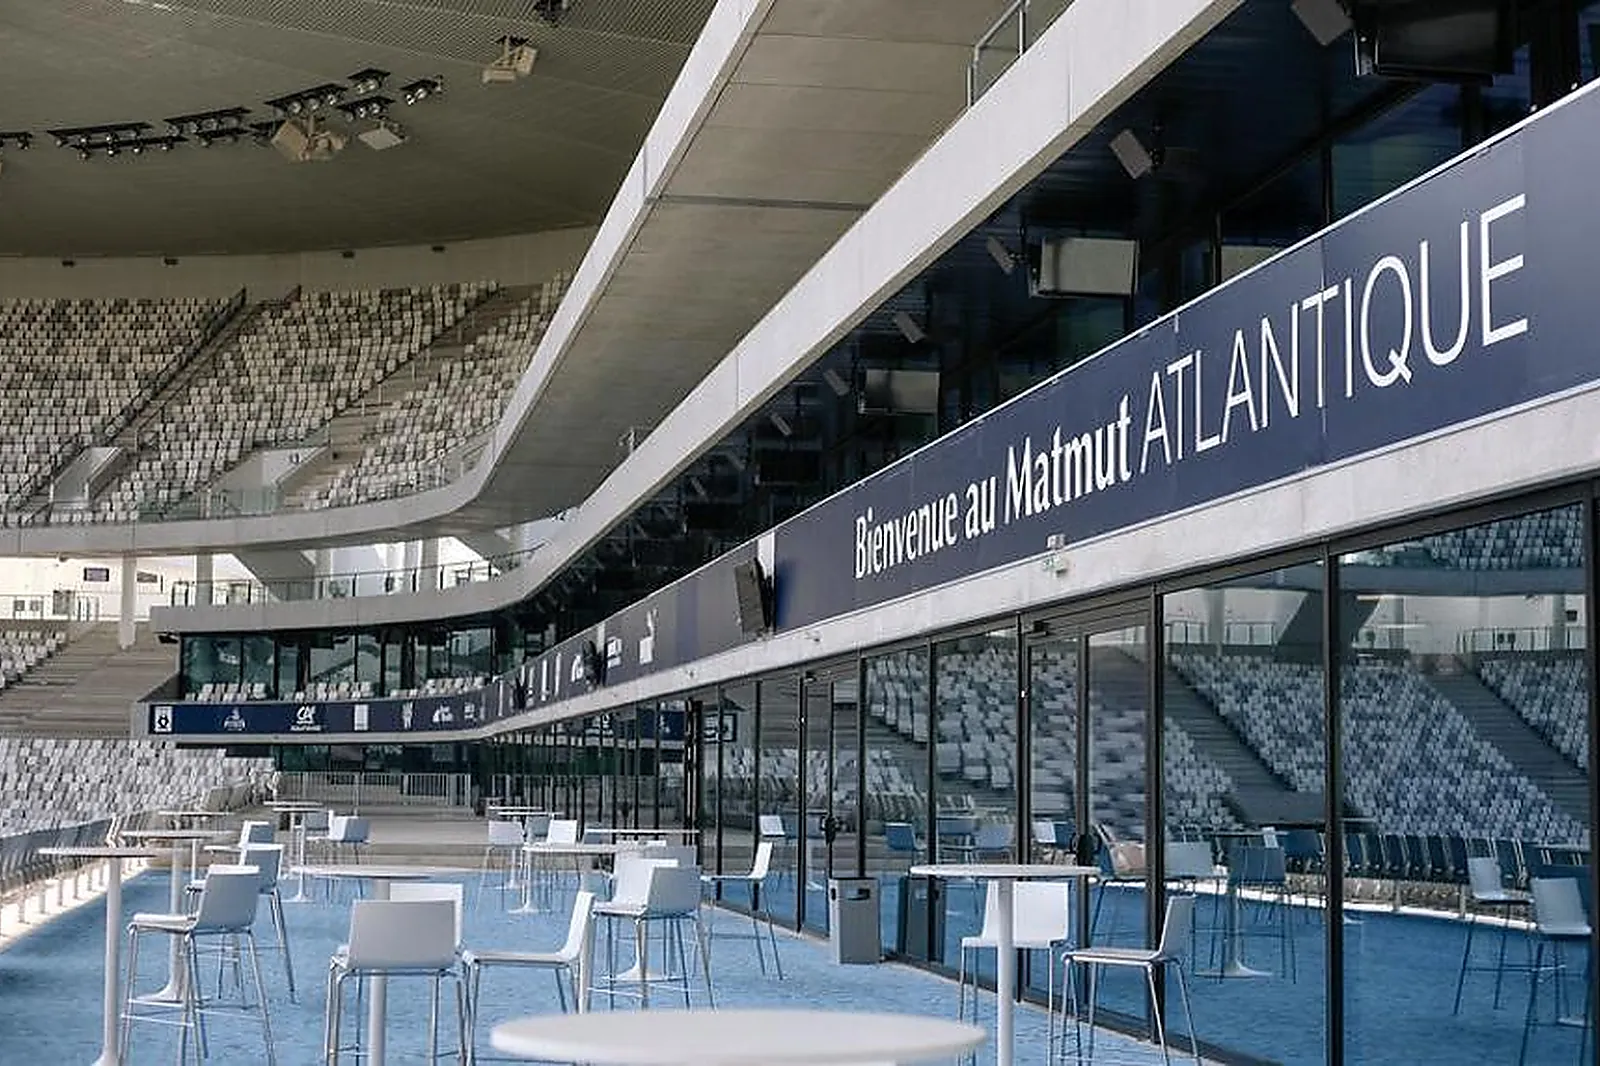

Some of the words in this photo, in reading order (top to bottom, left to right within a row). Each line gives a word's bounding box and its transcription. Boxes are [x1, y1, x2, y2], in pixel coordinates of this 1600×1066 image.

[854, 506, 959, 580] Bienvenue
[965, 476, 997, 540] au
[1004, 394, 1133, 526] Matmut
[1140, 192, 1529, 475] ATLANTIQUE
